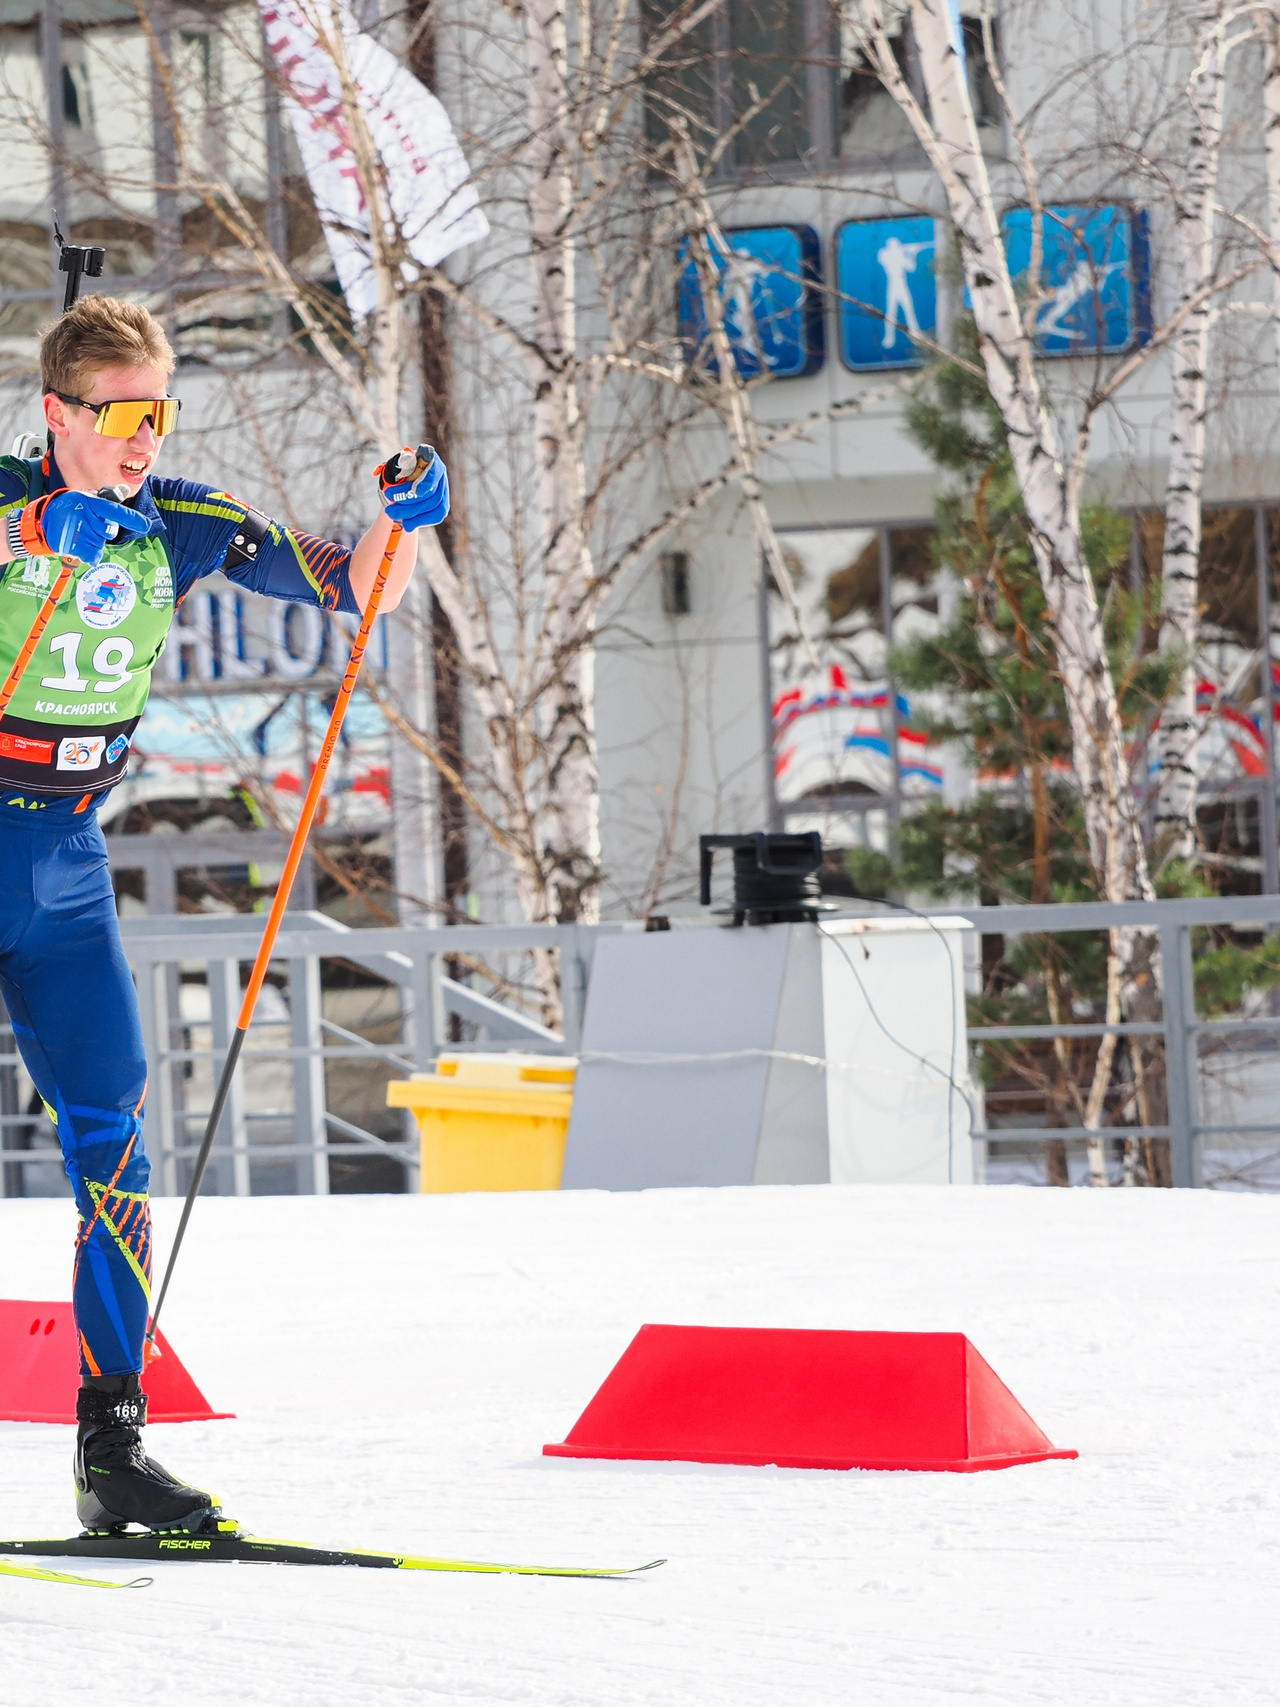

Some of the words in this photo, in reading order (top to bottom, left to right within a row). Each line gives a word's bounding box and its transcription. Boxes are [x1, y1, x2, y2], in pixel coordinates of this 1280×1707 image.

[152, 587, 173, 597] ЖИЗН
[165, 588, 389, 682] HLON
[40, 631, 135, 693] 19
[34, 700, 119, 716] КРАСНОЯРСК
[321, 735, 336, 770] PREMIO
[114, 1404, 138, 1418] 169
[159, 1539, 211, 1550] FISCHER
